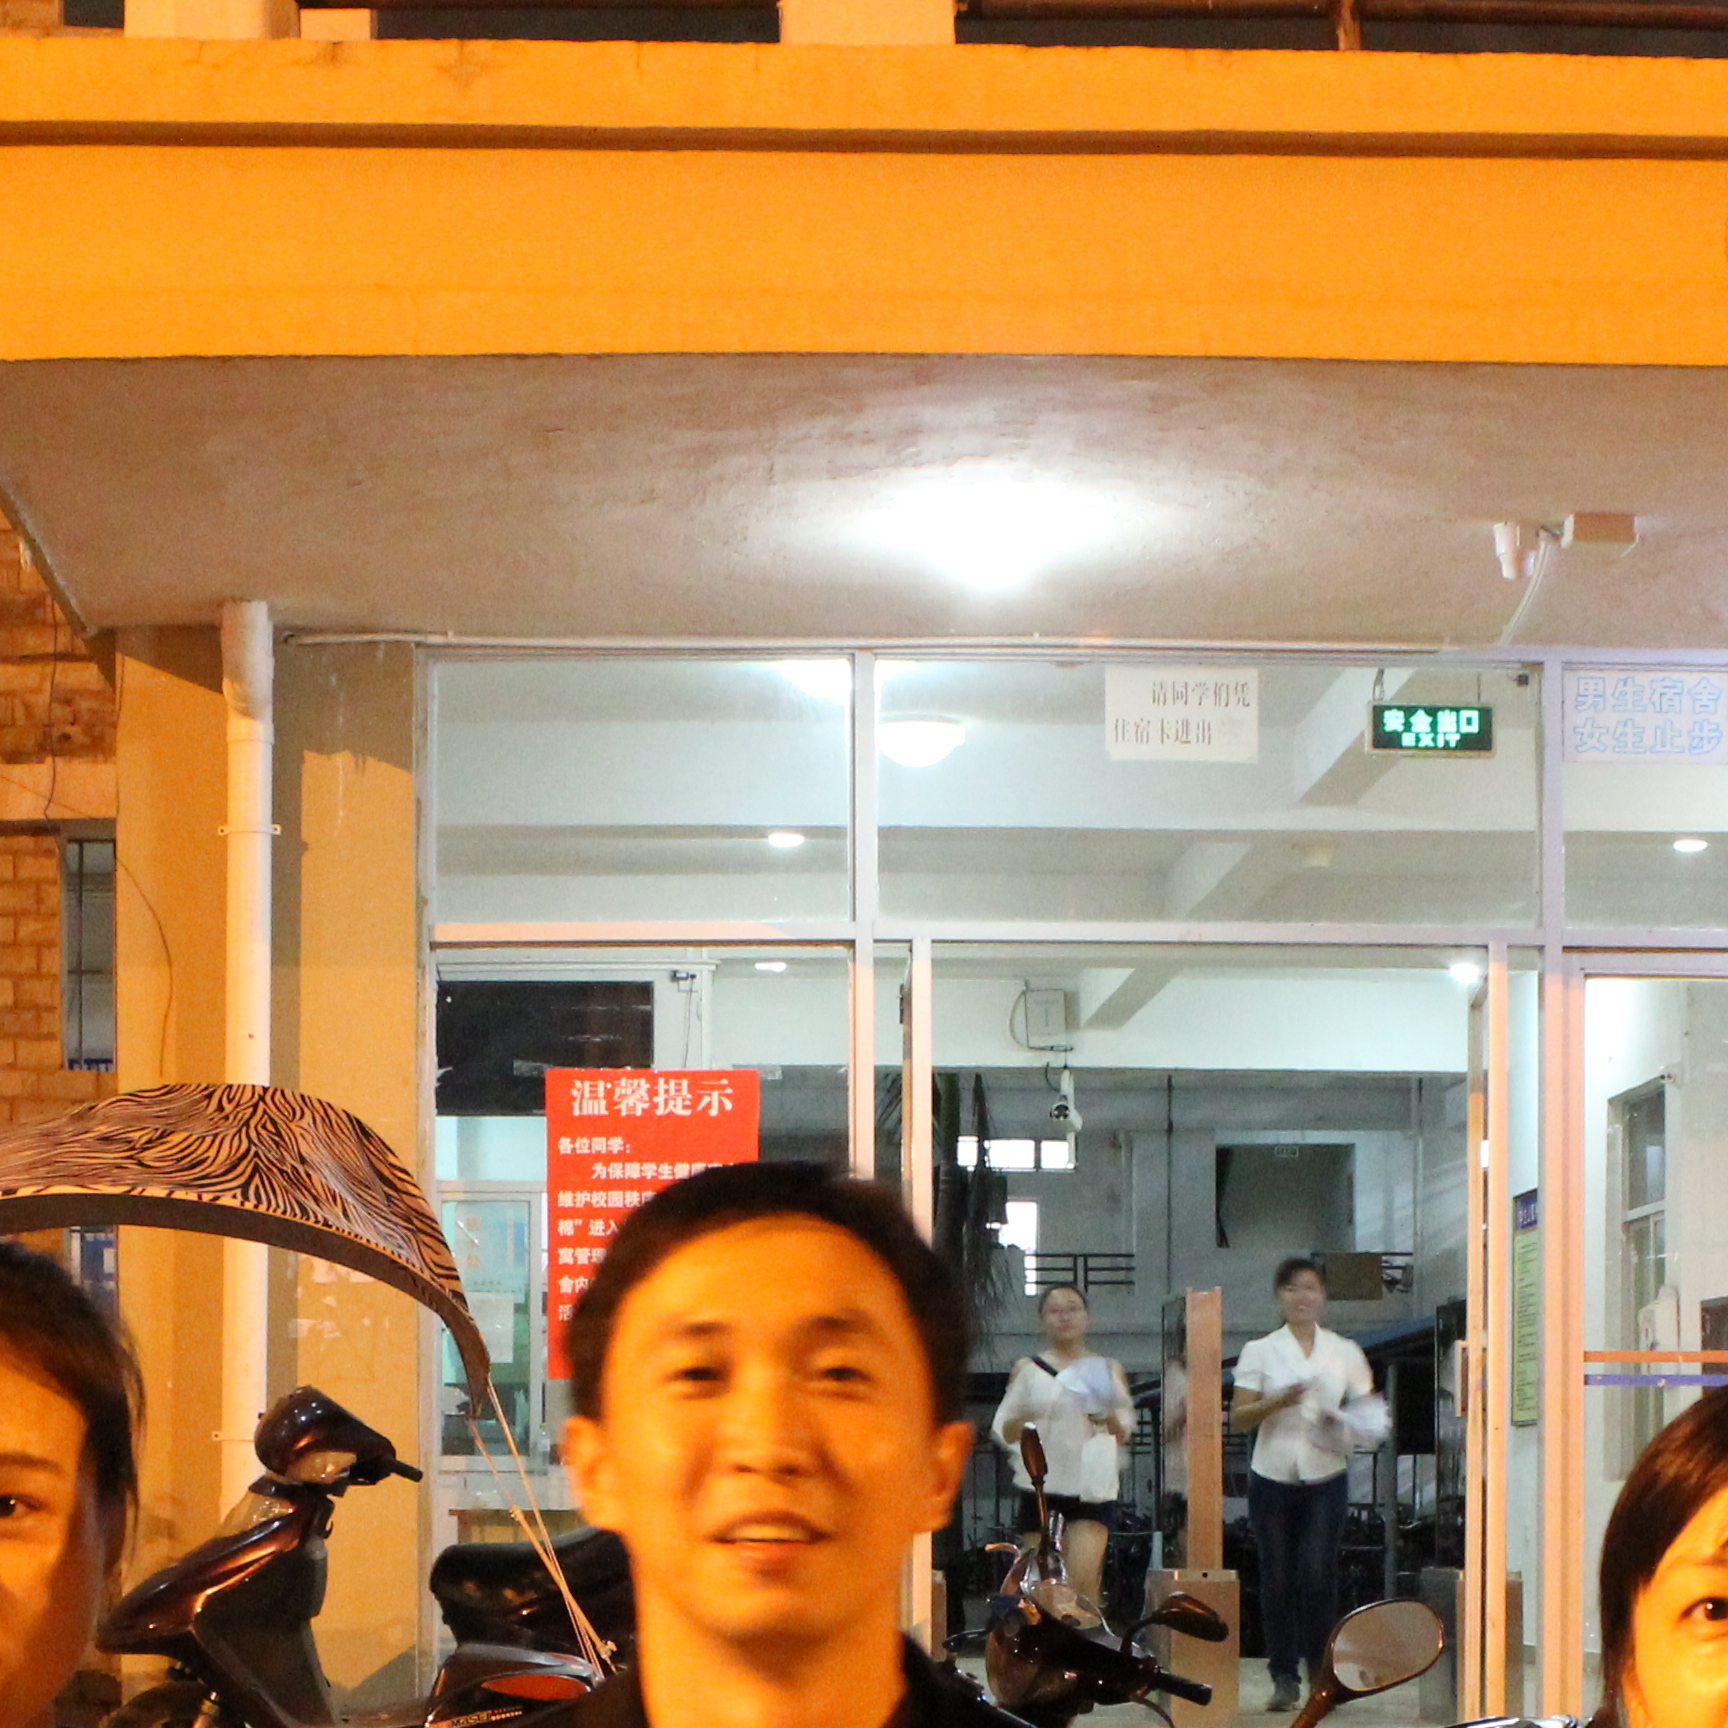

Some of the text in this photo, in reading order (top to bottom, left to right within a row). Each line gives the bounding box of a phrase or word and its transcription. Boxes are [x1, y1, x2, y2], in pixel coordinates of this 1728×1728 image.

[1151, 680, 1251, 708] 请同学们凭
[1574, 676, 1723, 714] 男生宿舍
[1113, 717, 1213, 745] 住宿卡进出
[1382, 709, 1480, 734] 安全出口
[1400, 733, 1461, 748] EXIT
[1573, 718, 1724, 755] 女生止步
[571, 1077, 734, 1117] 温馨提示
